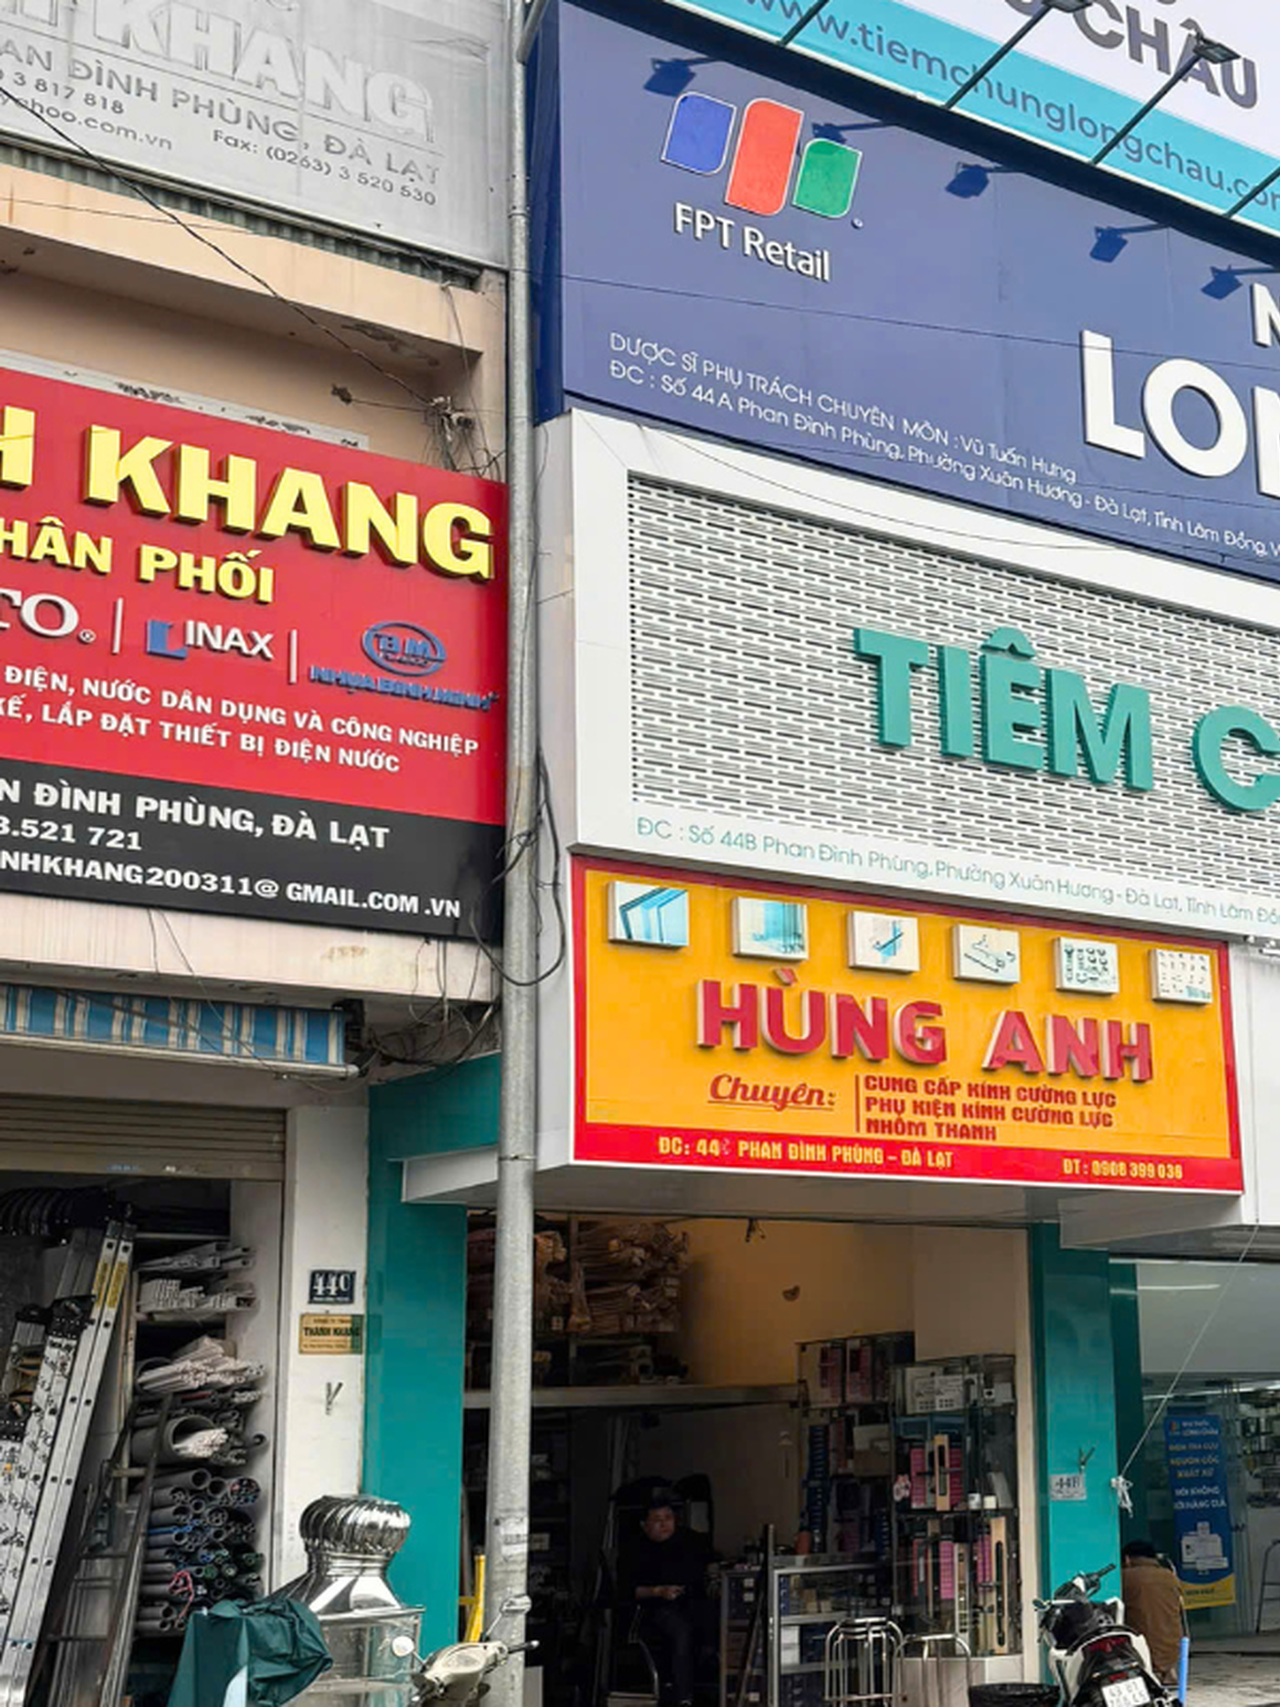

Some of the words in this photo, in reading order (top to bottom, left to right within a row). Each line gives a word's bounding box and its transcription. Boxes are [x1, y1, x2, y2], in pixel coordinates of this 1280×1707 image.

[14, 72, 26, 87] 3
[35, 78, 75, 100] 817
[83, 93, 124, 116] 818
[213, 130, 258, 154] Fax:
[339, 166, 351, 181] 3
[357, 172, 394, 194] 520
[400, 185, 436, 206] 530
[68, 59, 157, 102] ĐÌNH
[324, 134, 372, 166] ĐÀ
[387, 152, 440, 184] LẠT
[674, 203, 734, 249] FPT
[745, 226, 832, 282] Retail
[610, 332, 676, 366] DƯỢC
[682, 351, 699, 374] SĨ
[703, 360, 742, 389] PHỤ
[747, 373, 812, 406] TRÁCH
[817, 394, 895, 431] CHUYÊN
[902, 417, 950, 446] MÔN
[988, 442, 1027, 469] Tuấn
[1032, 454, 1077, 485] Hưng
[610, 359, 644, 385] ĐC
[661, 374, 687, 396] Số
[738, 397, 789, 426] Phan
[793, 411, 837, 439] Đình
[980, 464, 1024, 490] Xuân
[1028, 476, 1082, 509] Hương
[1095, 494, 1119, 515] Đà
[1187, 520, 1220, 542] Lâm
[85, 424, 494, 579] KHANG
[140, 544, 274, 604] PHỐI
[5, 664, 75, 696] ĐIỆN,
[82, 677, 151, 705] NƯỚC
[161, 689, 212, 714] DÂN
[220, 699, 287, 726] DỤNG
[293, 709, 324, 732] VÀ
[331, 716, 393, 742] CÔNG
[399, 728, 479, 757] NGHIỆP
[100, 713, 151, 738] ĐẶT
[159, 721, 231, 748] THIẾT
[240, 733, 265, 757] BỊ
[275, 738, 331, 763] ĐIỆN
[339, 747, 401, 773] NƯỚC
[853, 626, 1154, 793] TIÊM
[33, 778, 121, 816] ĐÌNH
[136, 794, 264, 838] PHÙNG,
[271, 810, 317, 840] ĐÀ
[330, 821, 390, 851] LẠT
[87, 826, 142, 851] 721
[637, 817, 672, 840] ĐC
[688, 824, 715, 845] Số
[720, 829, 758, 851] 44B
[763, 835, 815, 859] Phan
[819, 843, 863, 867] Đình
[1009, 871, 1055, 892] Xuân
[1125, 887, 1150, 906] Đà
[1220, 903, 1254, 921] Lâm
[697, 967, 948, 1066] HÙNG
[981, 1009, 1154, 1083] ANH
[709, 1072, 836, 1113] Chuyên:
[864, 1074, 917, 1093] CUNG
[923, 1074, 961, 1097] CẤP
[968, 1080, 1010, 1101] KÍNH
[1016, 1083, 1077, 1106] CƯỜNG
[1082, 1090, 1116, 1109] LỰC
[865, 1096, 906, 1118] PHỤ
[912, 1098, 956, 1119] KIỆN
[963, 1101, 1005, 1121] KÍNH
[1012, 1103, 1074, 1126] CƯỜNG
[1080, 1110, 1113, 1130] LỰC
[865, 1115, 927, 1137] NHÔM
[933, 1121, 997, 1141] THANH
[658, 1134, 691, 1155] ĐC:
[738, 1140, 783, 1160] PHAN
[788, 1138, 827, 1162] ĐÌNH
[832, 1142, 884, 1165] PHÙNG
[901, 1146, 923, 1166] ĐÀ
[927, 1149, 953, 1170] LẠT
